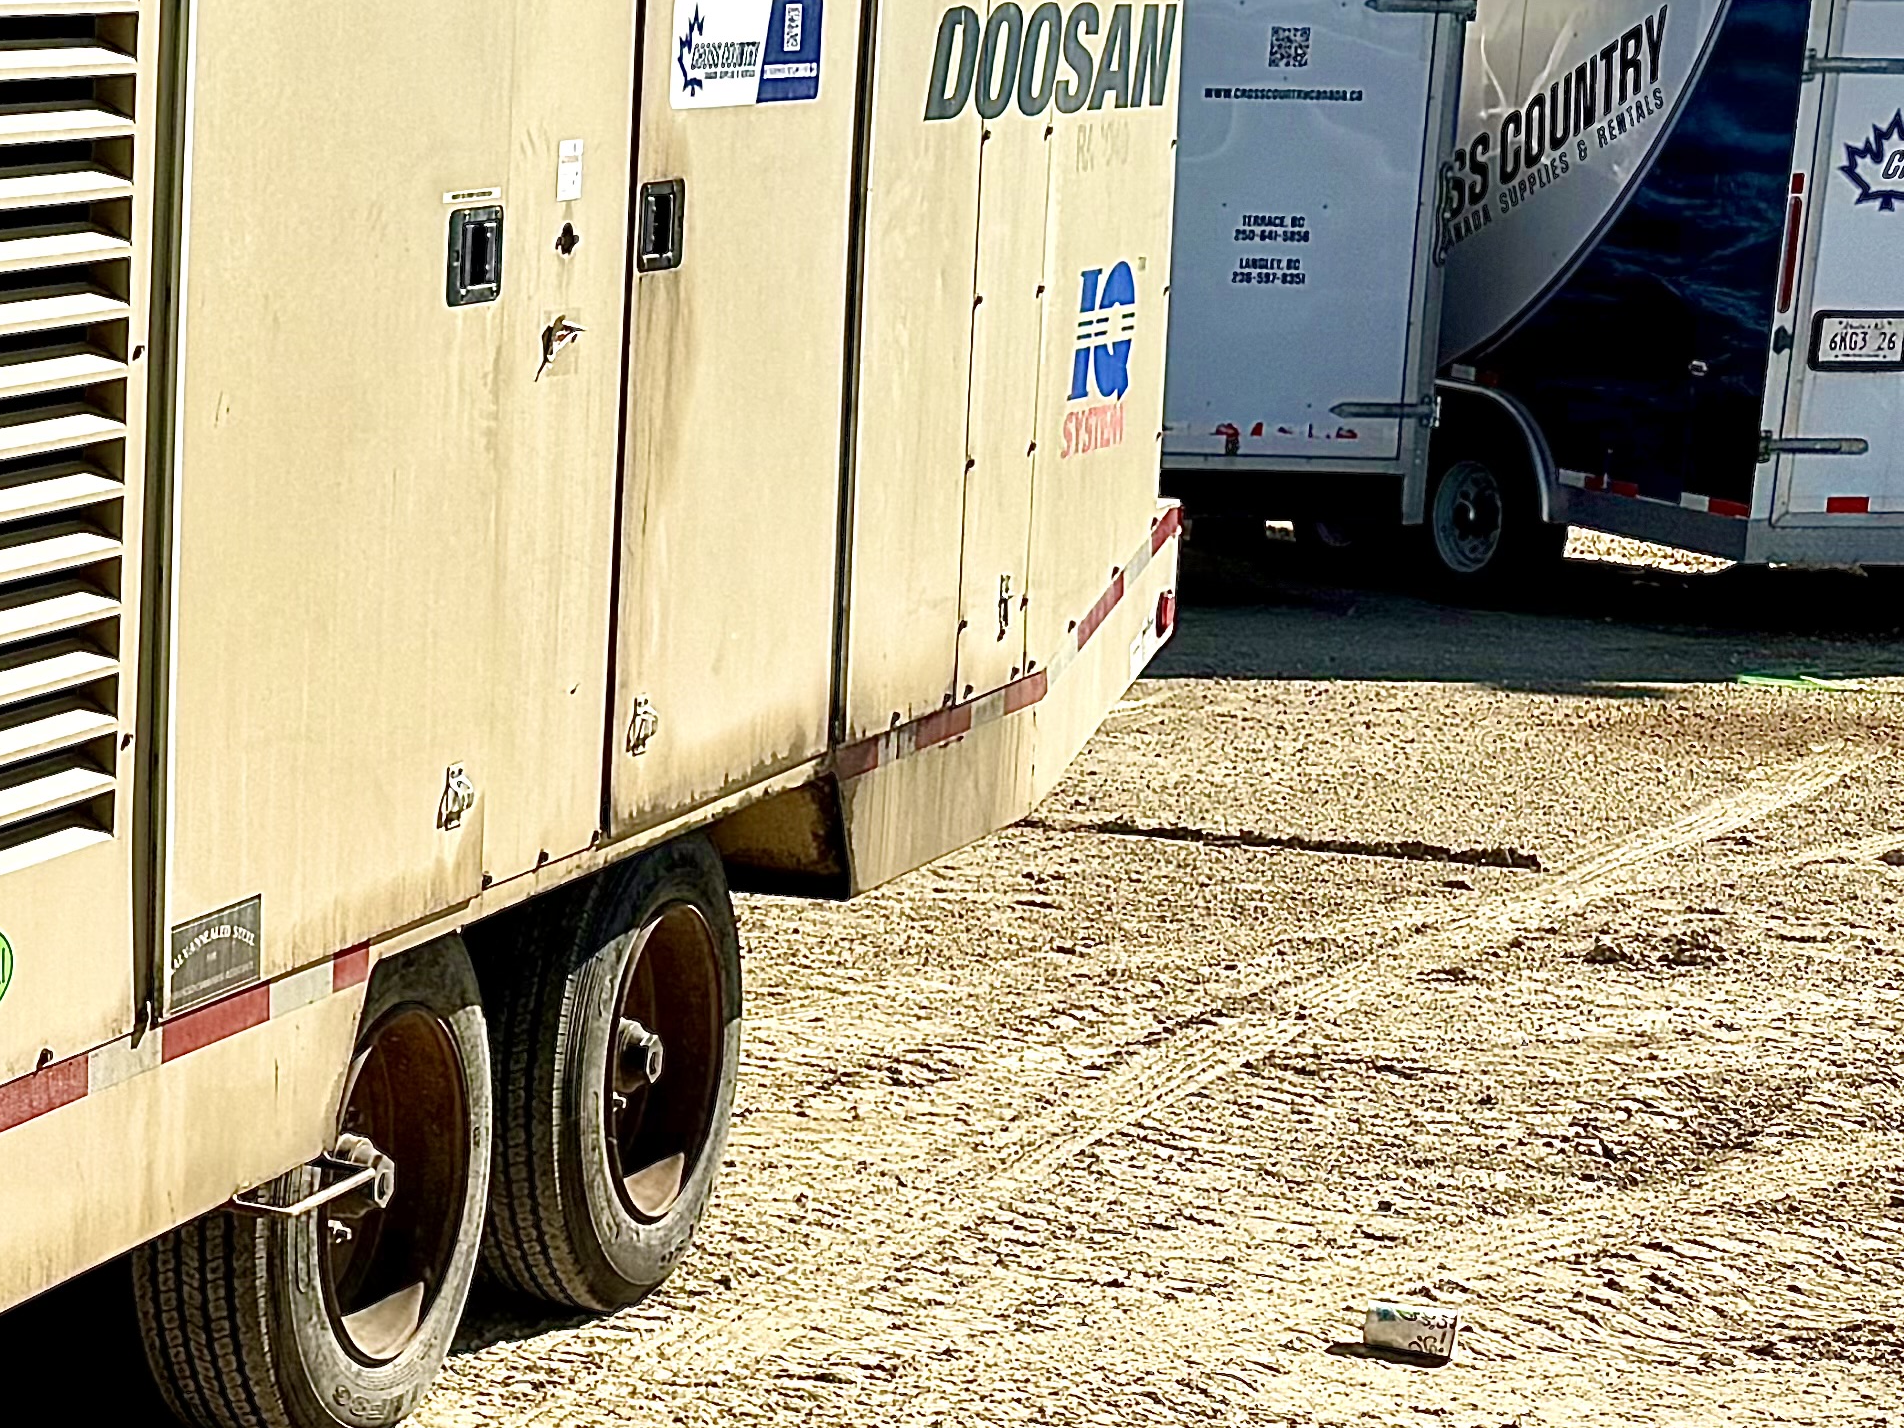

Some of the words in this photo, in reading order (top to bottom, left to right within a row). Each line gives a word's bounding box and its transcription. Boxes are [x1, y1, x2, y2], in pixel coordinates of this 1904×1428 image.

[923, 1, 1178, 121] DOOSAN
[1499, 4, 1668, 186] COUNTRY
[1499, 150, 1570, 214] SUPPLIES
[1577, 139, 1588, 162] &
[1596, 87, 1665, 149] RENTALS
[1066, 260, 1136, 401] IQ
[1060, 402, 1125, 459] SYSTEM
